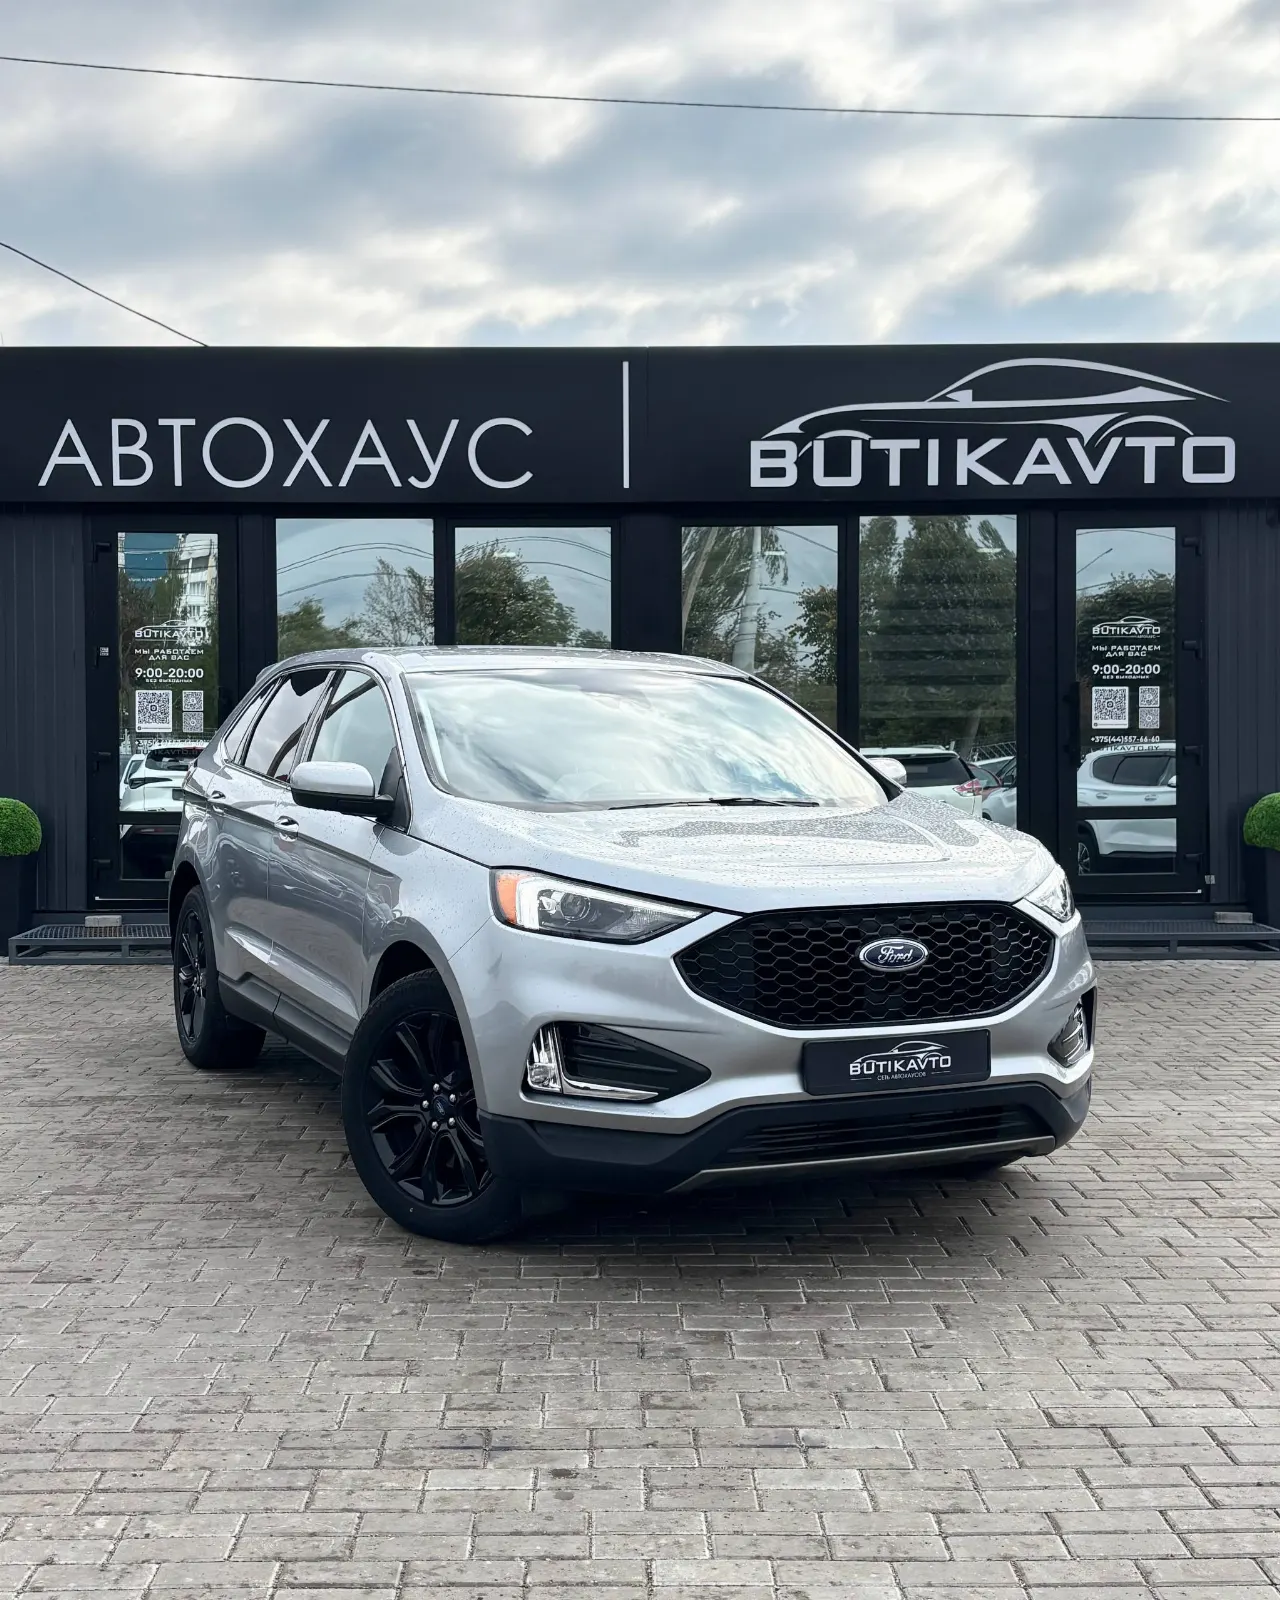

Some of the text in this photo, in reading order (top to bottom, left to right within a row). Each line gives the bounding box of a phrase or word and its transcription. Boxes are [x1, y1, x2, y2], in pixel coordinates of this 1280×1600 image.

[38, 417, 534, 489] АВТОХАУС
[750, 436, 1236, 488] BUTIKAVTO
[134, 629, 204, 638] BUTIKAVTO
[1092, 626, 1161, 635] BUTIKAVTO
[135, 667, 204, 678] 9:00-20:00
[1092, 664, 1161, 675] 9:00-20:00
[1091, 735, 1160, 743] +375(44)557-66-60
[878, 945, 914, 963] Ford
[849, 1055, 952, 1075] BUTIKAVTO
